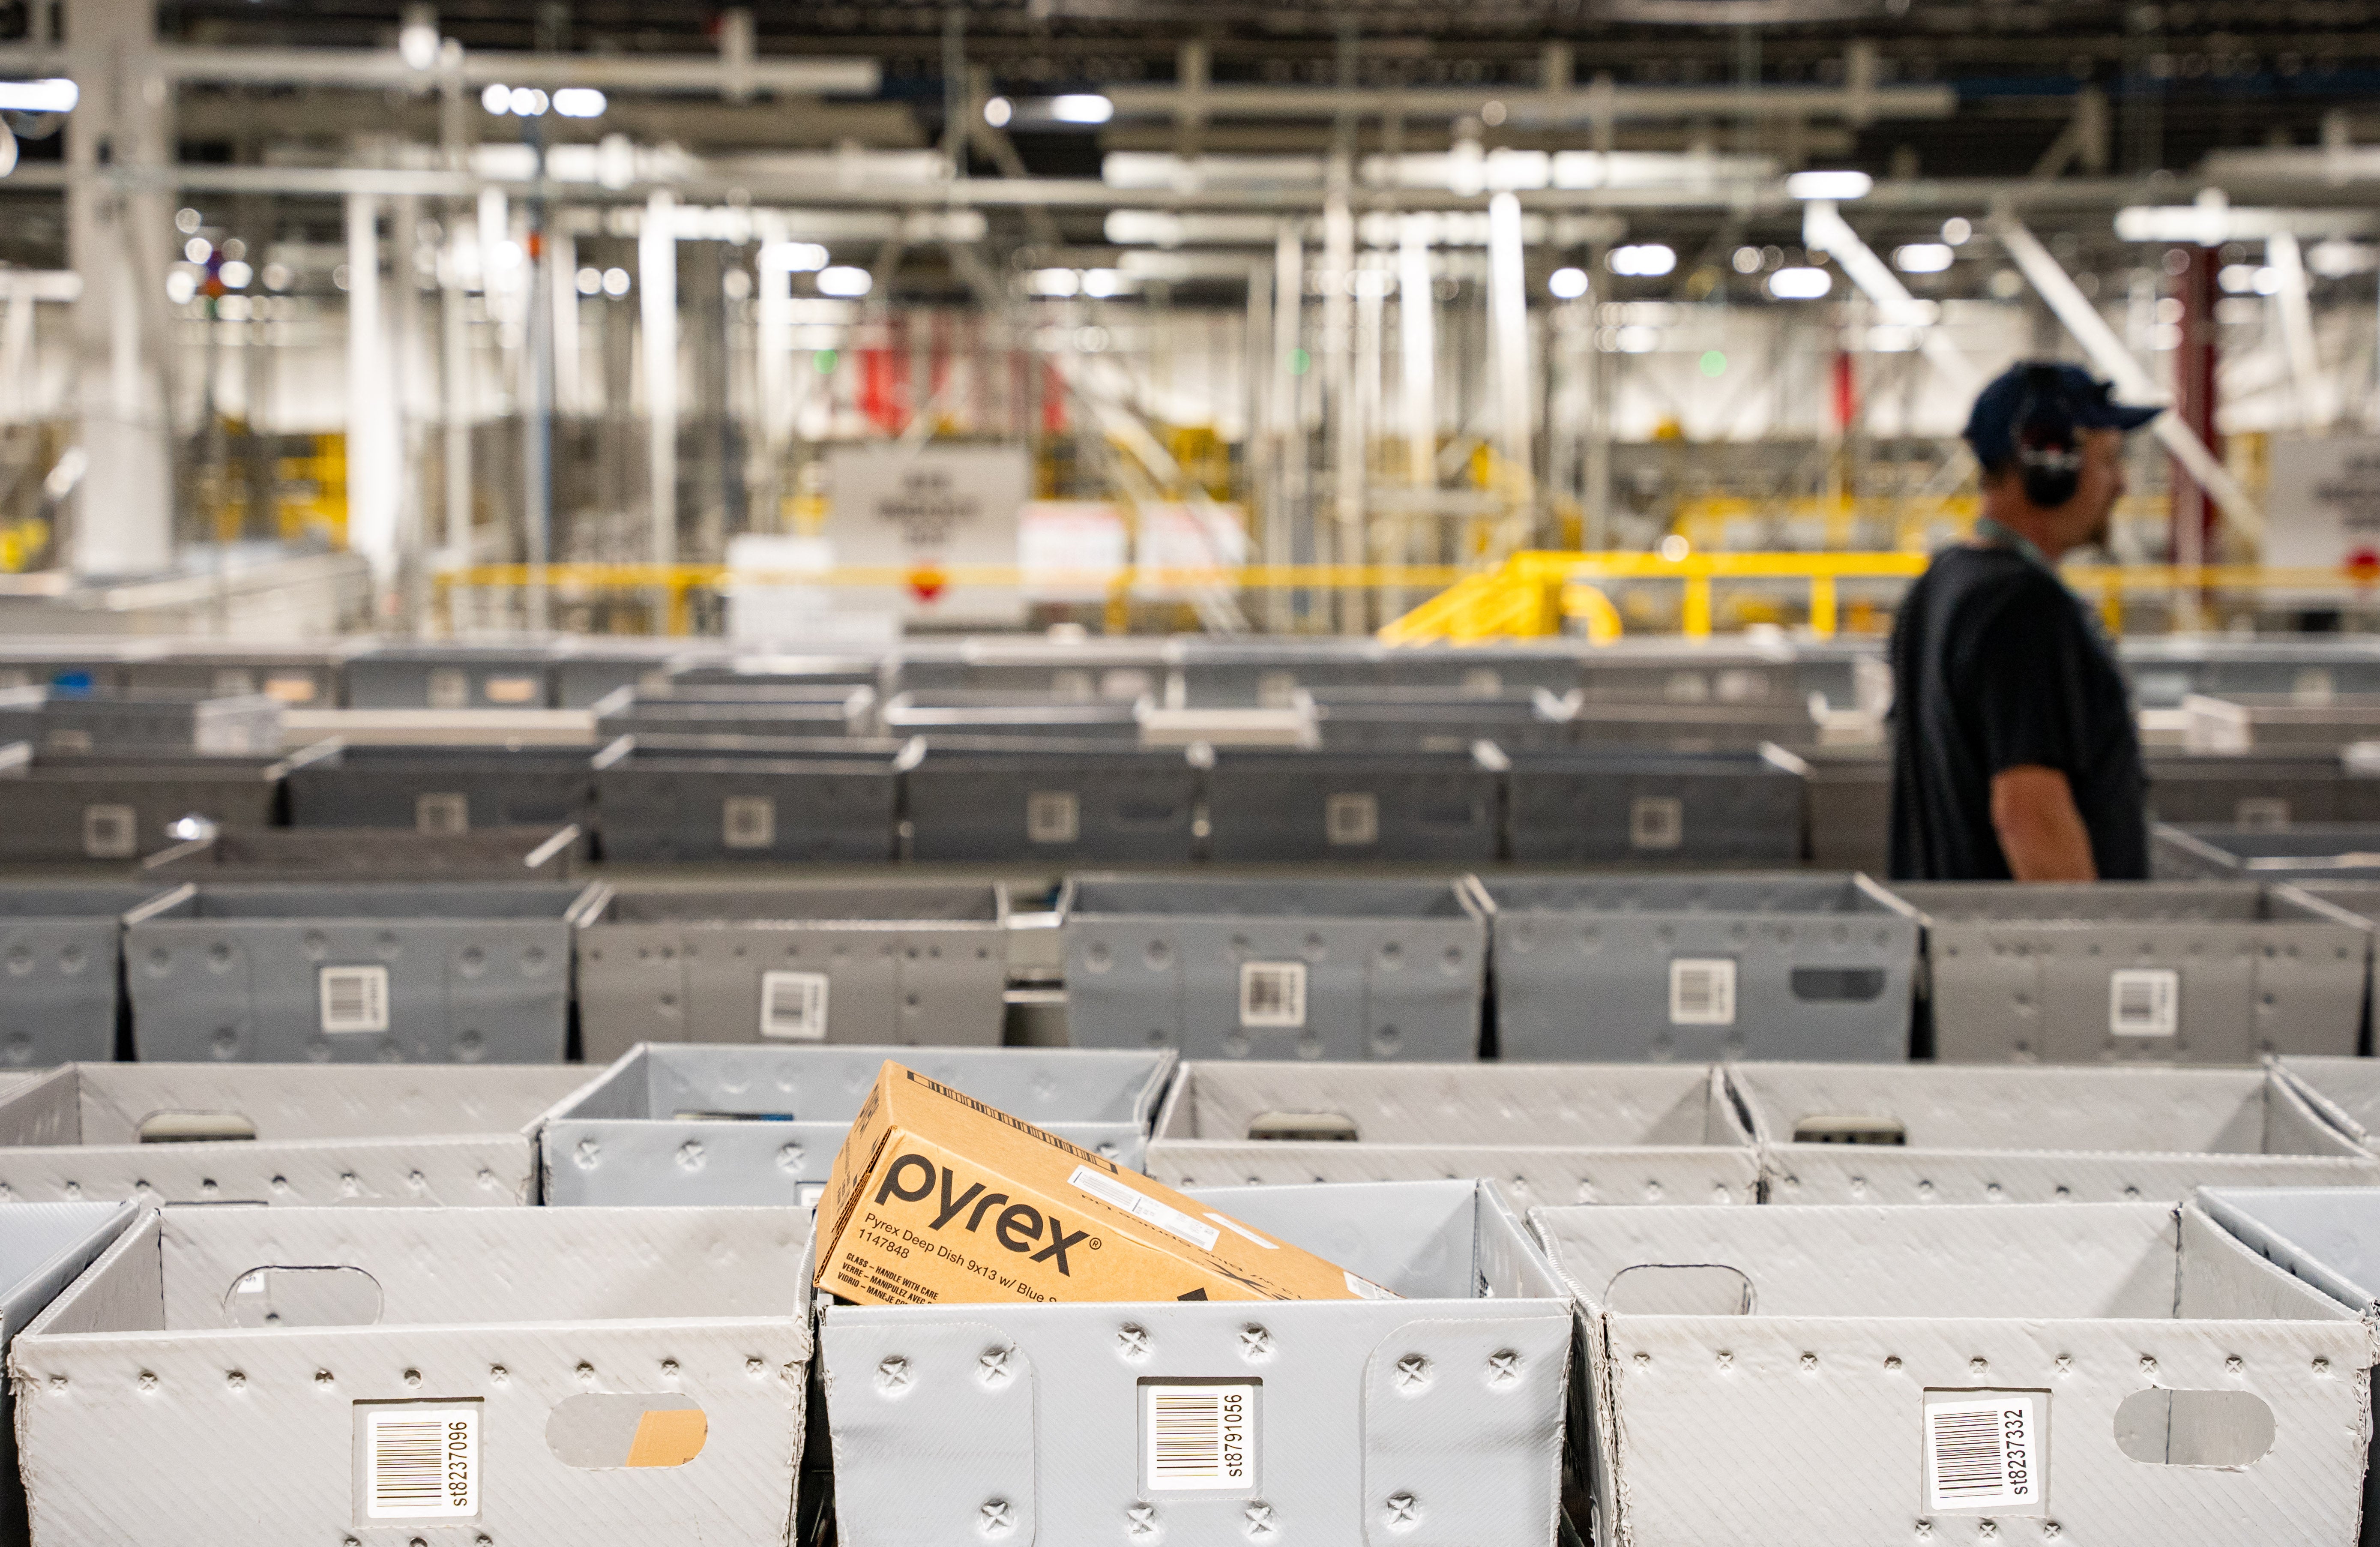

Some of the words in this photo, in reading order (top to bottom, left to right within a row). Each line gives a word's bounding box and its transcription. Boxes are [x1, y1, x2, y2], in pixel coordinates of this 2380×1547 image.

[1081, 1194, 1111, 1211] Lid
[859, 1229, 910, 1258] 1147848
[1119, 1212, 1191, 1247] Spruce
[846, 1253, 868, 1268] GLASS
[875, 1266, 902, 1283] HANDLE
[902, 1278, 920, 1292] WITH
[920, 1287, 939, 1300] CARE
[865, 1212, 901, 1237] Pyrex
[902, 1229, 934, 1253] Deep
[937, 1245, 964, 1266] Dish
[967, 1260, 997, 1280] 9x13
[1000, 1276, 1017, 1288] w/
[1017, 1283, 1044, 1302] Blue
[837, 1271, 859, 1288] VIDRIO
[866, 1286, 895, 1304] MANEJE
[842, 1262, 864, 1277] VERRE
[870, 1275, 908, 1297] MANIPULEZ
[907, 1293, 926, 1304] AVEC
[1224, 1394, 1242, 1477] st8791056
[2004, 1409, 2028, 1495] st8237332
[449, 1422, 467, 1506] st8237096
